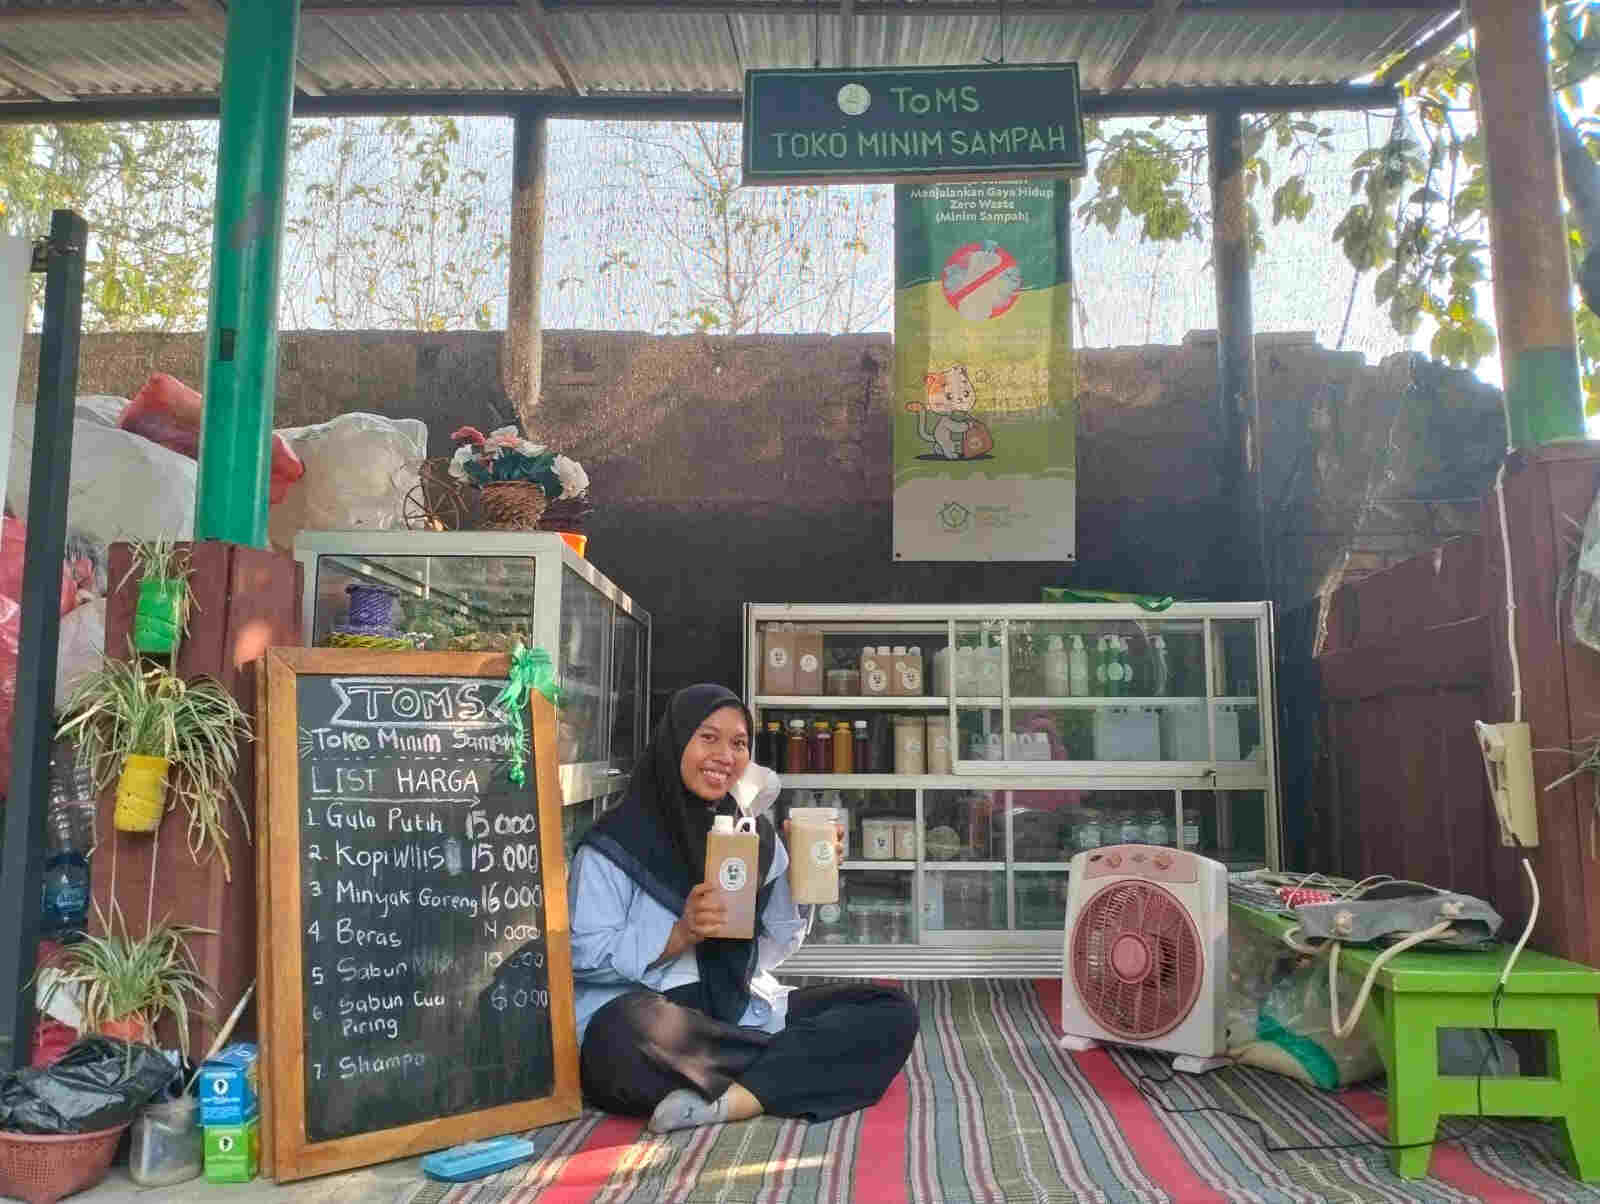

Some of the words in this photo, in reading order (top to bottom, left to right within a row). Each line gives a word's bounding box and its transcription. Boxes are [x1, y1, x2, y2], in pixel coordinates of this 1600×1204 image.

[772, 131, 847, 160] TOKO
[857, 129, 943, 158] MINIM
[951, 125, 1066, 156] SAMPAH
[910, 186, 985, 200] Menjalankan
[986, 186, 1016, 199] Gaya
[1018, 186, 1055, 200] Hidup
[949, 199, 977, 209] Zero
[979, 199, 1015, 209] Waste
[935, 210, 977, 224] (Minim
[347, 682, 487, 721] TOMS
[312, 727, 371, 752] Toko
[377, 726, 442, 753] Minim
[311, 765, 377, 794] LIST
[396, 767, 480, 794] HARGA
[326, 802, 377, 830] Gula
[387, 807, 443, 834] Putih
[335, 839, 388, 877] Kopi
[335, 880, 410, 918] Minyak
[418, 888, 480, 918] Goreng
[335, 918, 403, 948] Beras
[336, 955, 408, 983] Sabun
[338, 992, 404, 1015] Sabun
[342, 1017, 399, 1039] Piring
